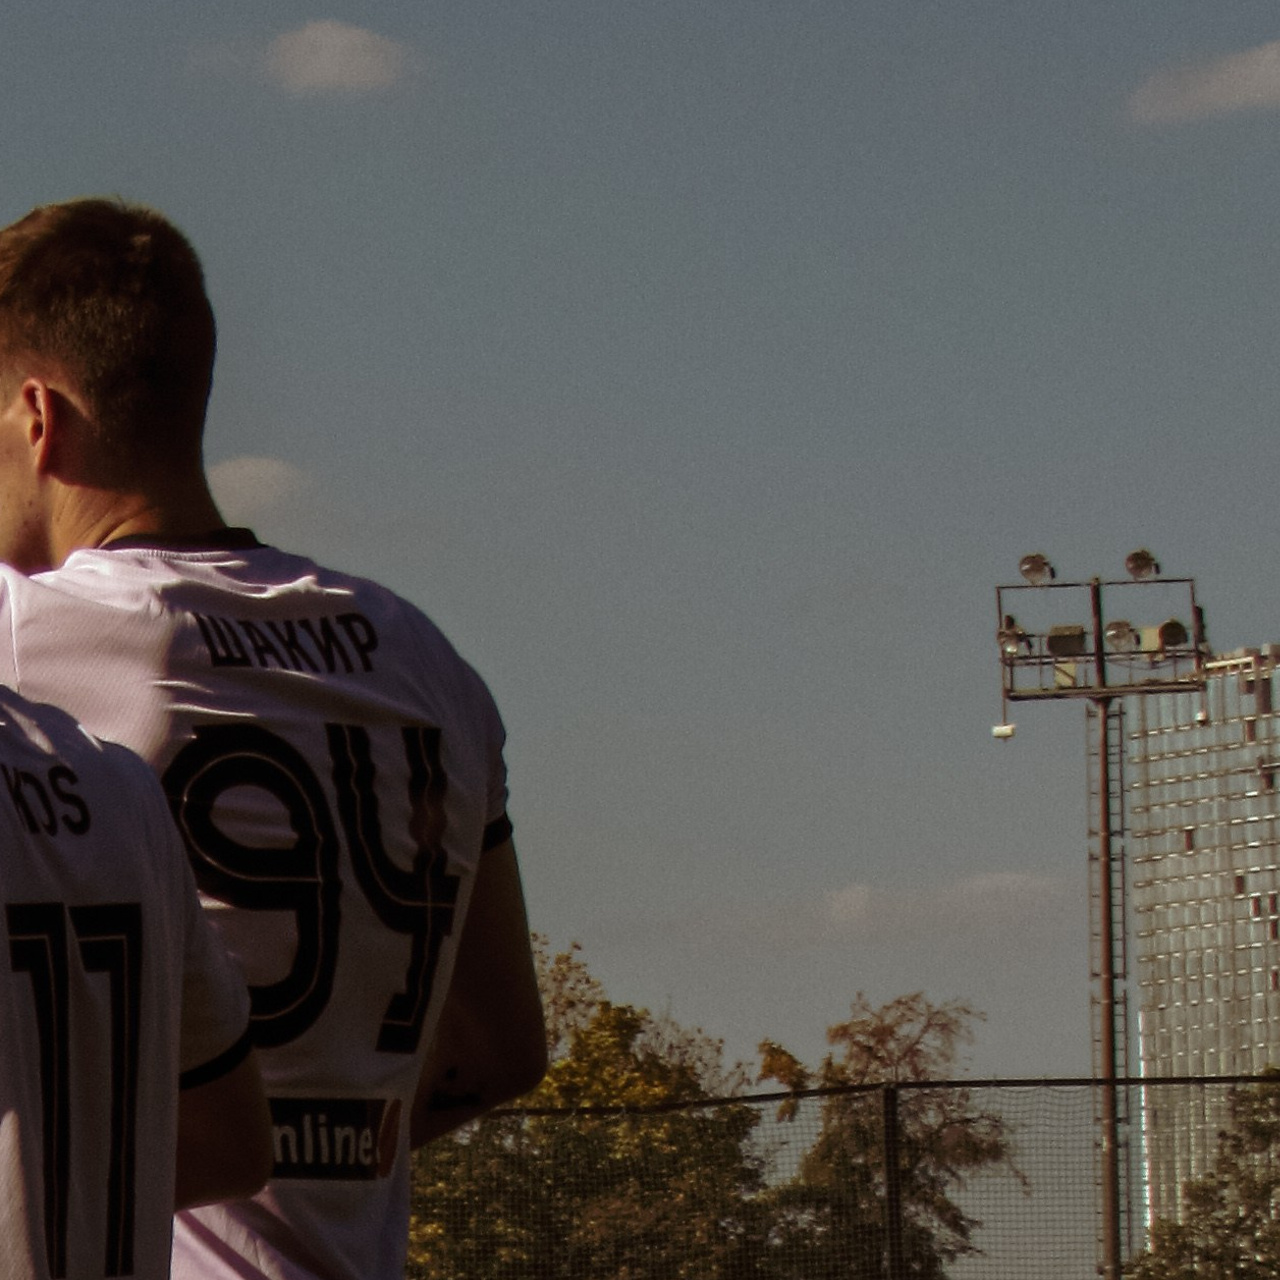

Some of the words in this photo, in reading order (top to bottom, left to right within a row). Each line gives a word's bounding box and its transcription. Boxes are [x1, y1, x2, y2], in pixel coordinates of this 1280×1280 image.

[193, 611, 379, 674] ШАКИР
[161, 722, 460, 1054] 94
[5, 902, 142, 1280] 11
[272, 1112, 374, 1166] nline
